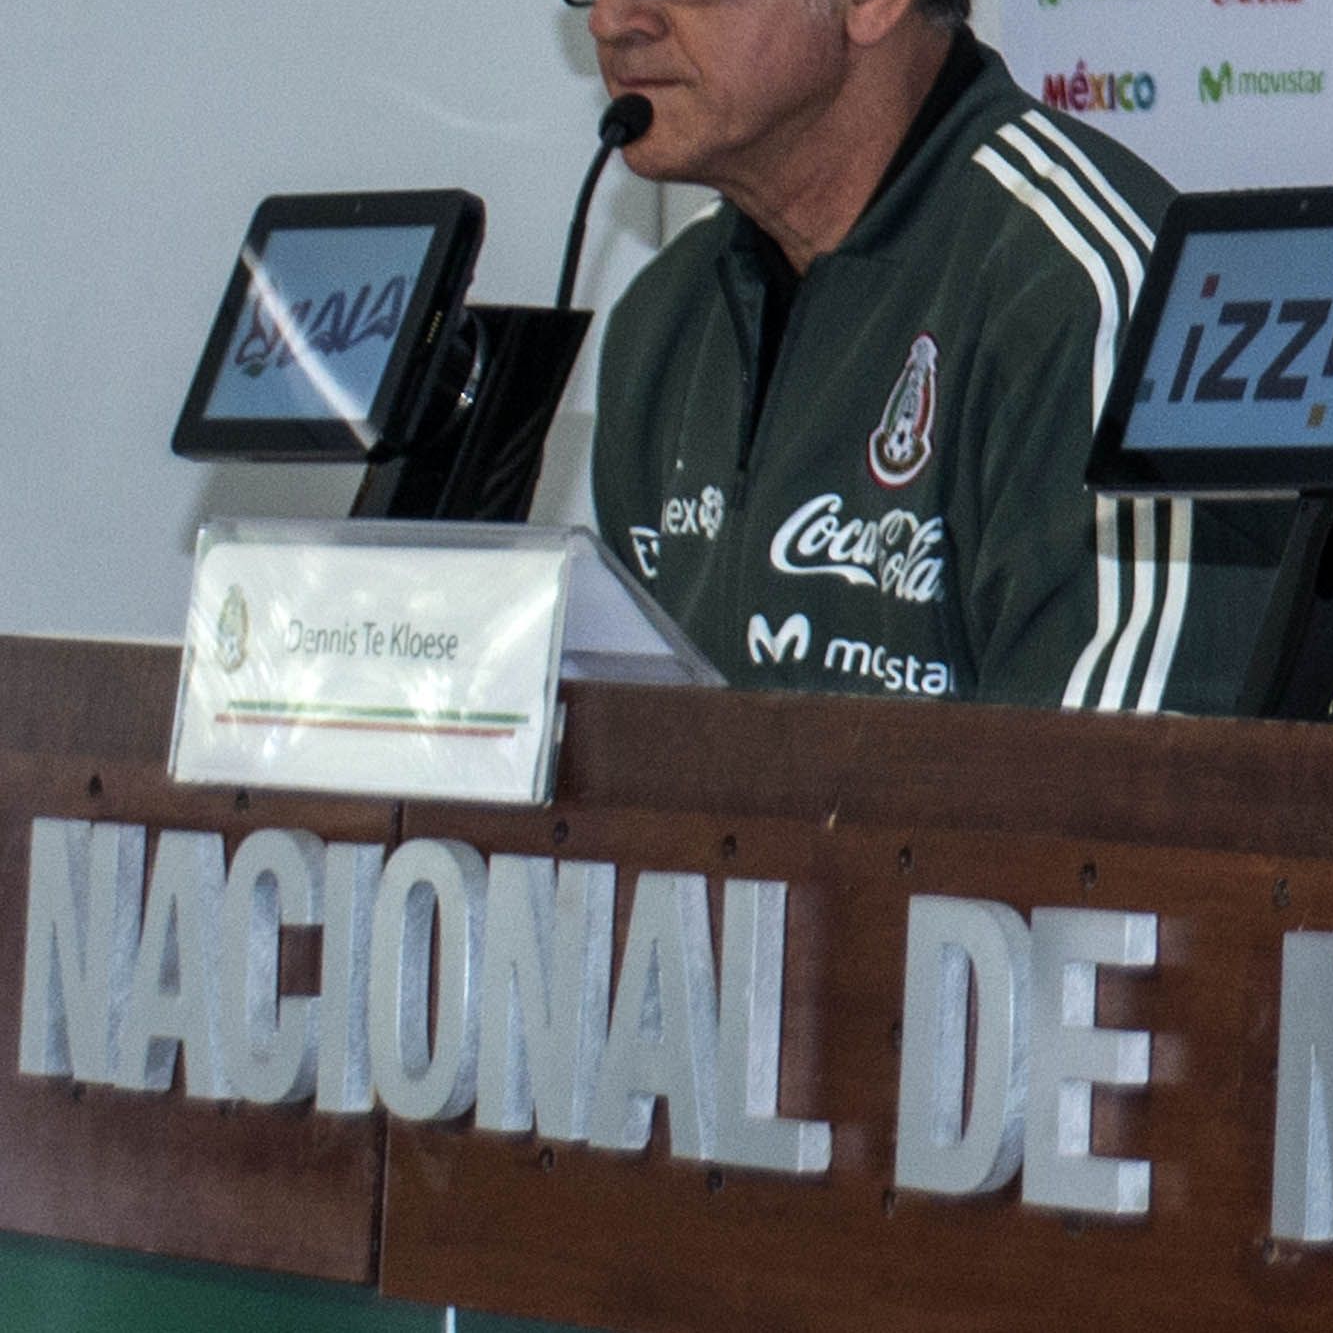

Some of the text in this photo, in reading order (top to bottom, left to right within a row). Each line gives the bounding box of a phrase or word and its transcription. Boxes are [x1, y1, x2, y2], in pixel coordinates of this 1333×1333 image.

[1238, 68, 1325, 97] movistar
[283, 618, 459, 661] Dennis Te Kloese
[18, 814, 834, 1176] NACIONAL
[892, 893, 1159, 1216] DE
